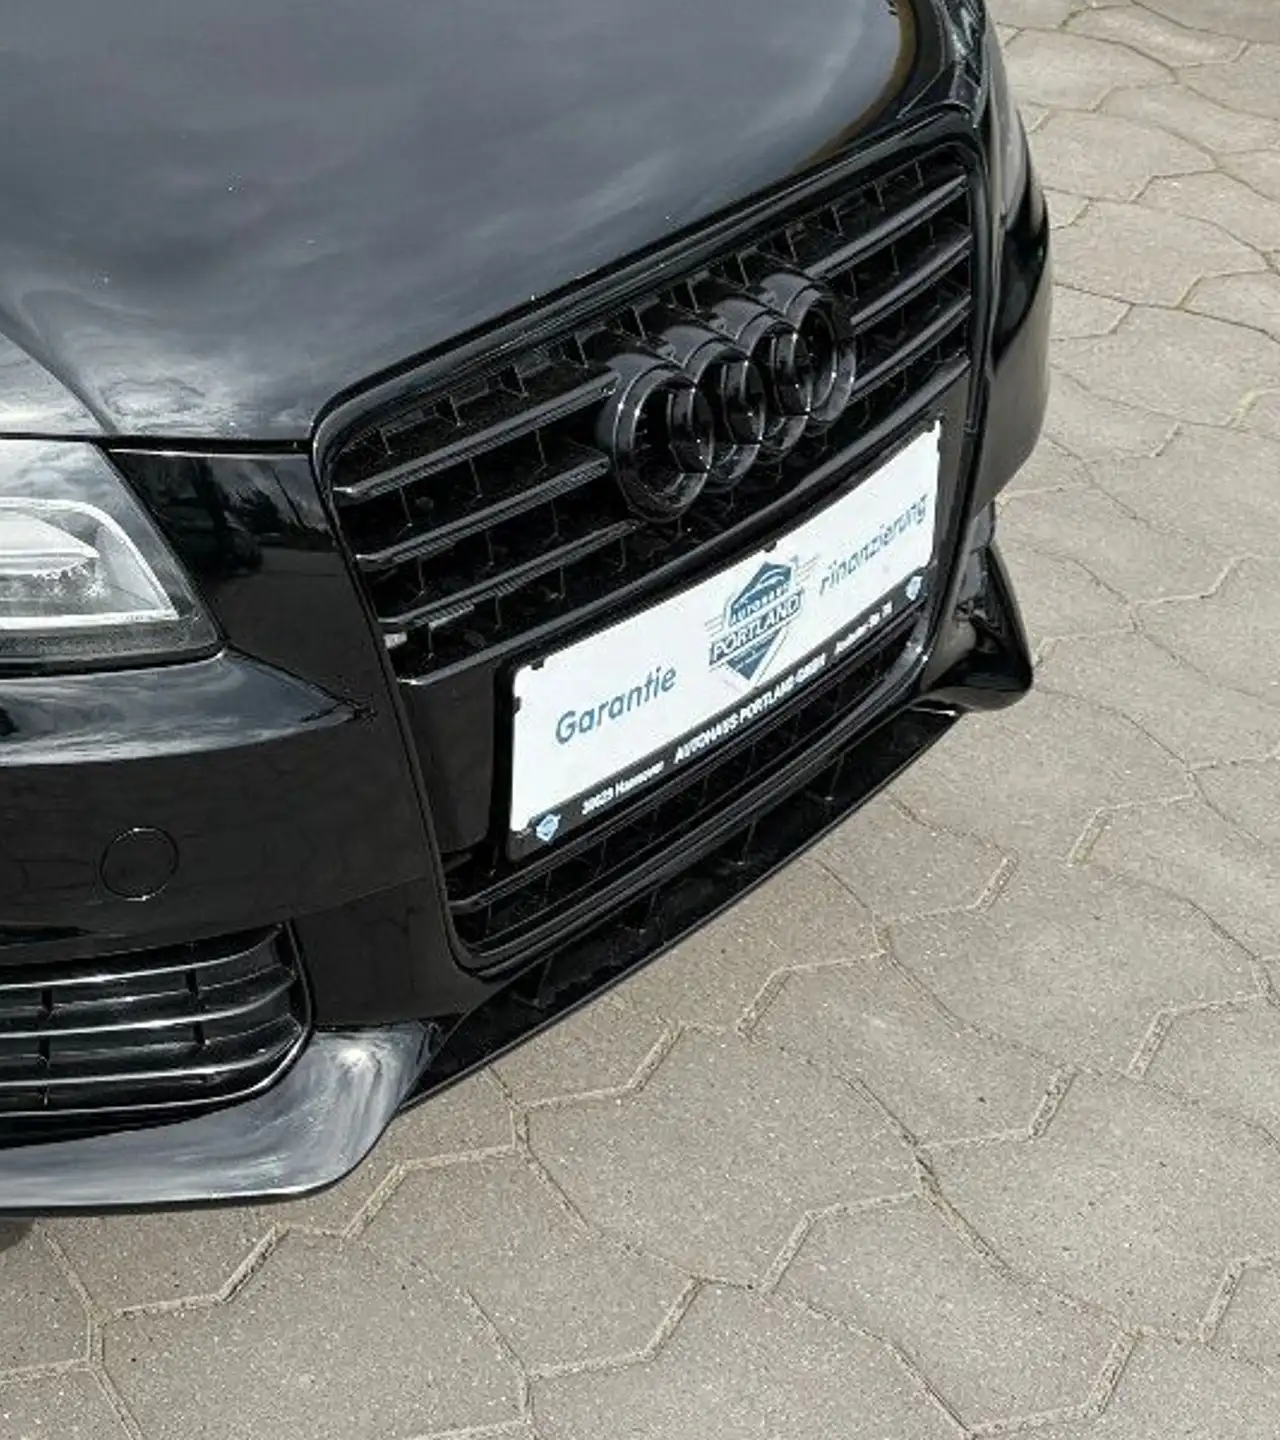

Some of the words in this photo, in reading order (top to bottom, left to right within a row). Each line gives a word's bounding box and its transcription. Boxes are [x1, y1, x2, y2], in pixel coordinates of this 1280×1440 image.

[819, 494, 927, 596] Finanzierung
[713, 594, 800, 661] PORTLAND
[556, 666, 676, 744] Garantie
